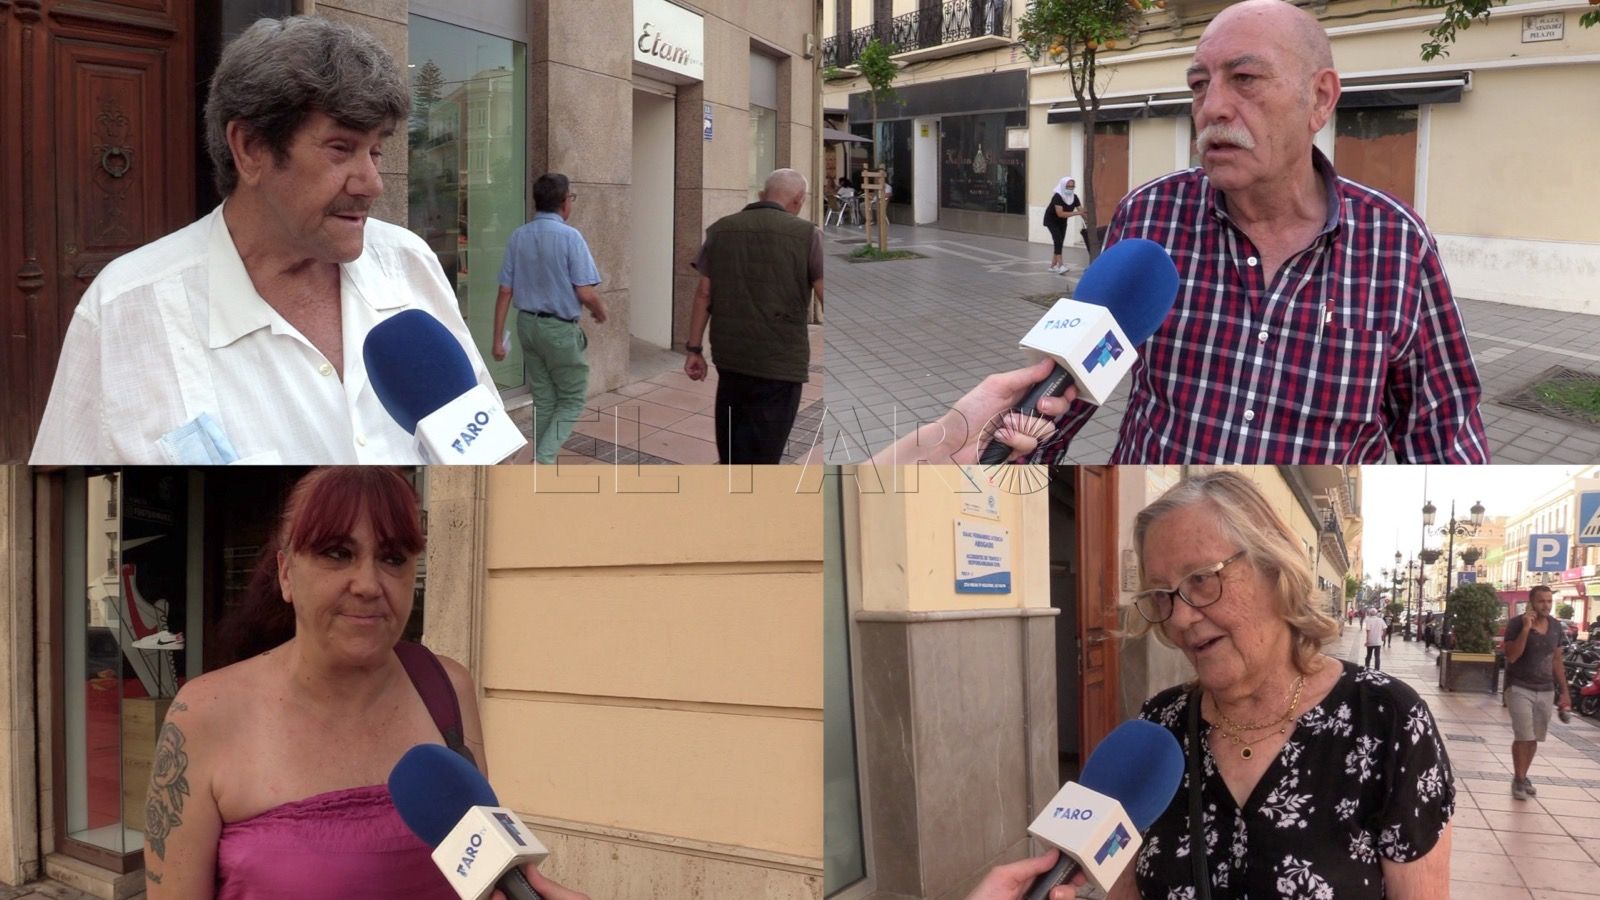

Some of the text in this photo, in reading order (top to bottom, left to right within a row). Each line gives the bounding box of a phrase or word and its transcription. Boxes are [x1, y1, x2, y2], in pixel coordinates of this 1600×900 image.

[638, 22, 689, 66] Etam
[1044, 317, 1081, 330] FARO
[451, 410, 489, 454] FARO
[1536, 538, 1560, 567] P
[1053, 807, 1093, 820] FARO
[456, 833, 482, 877] FARO
